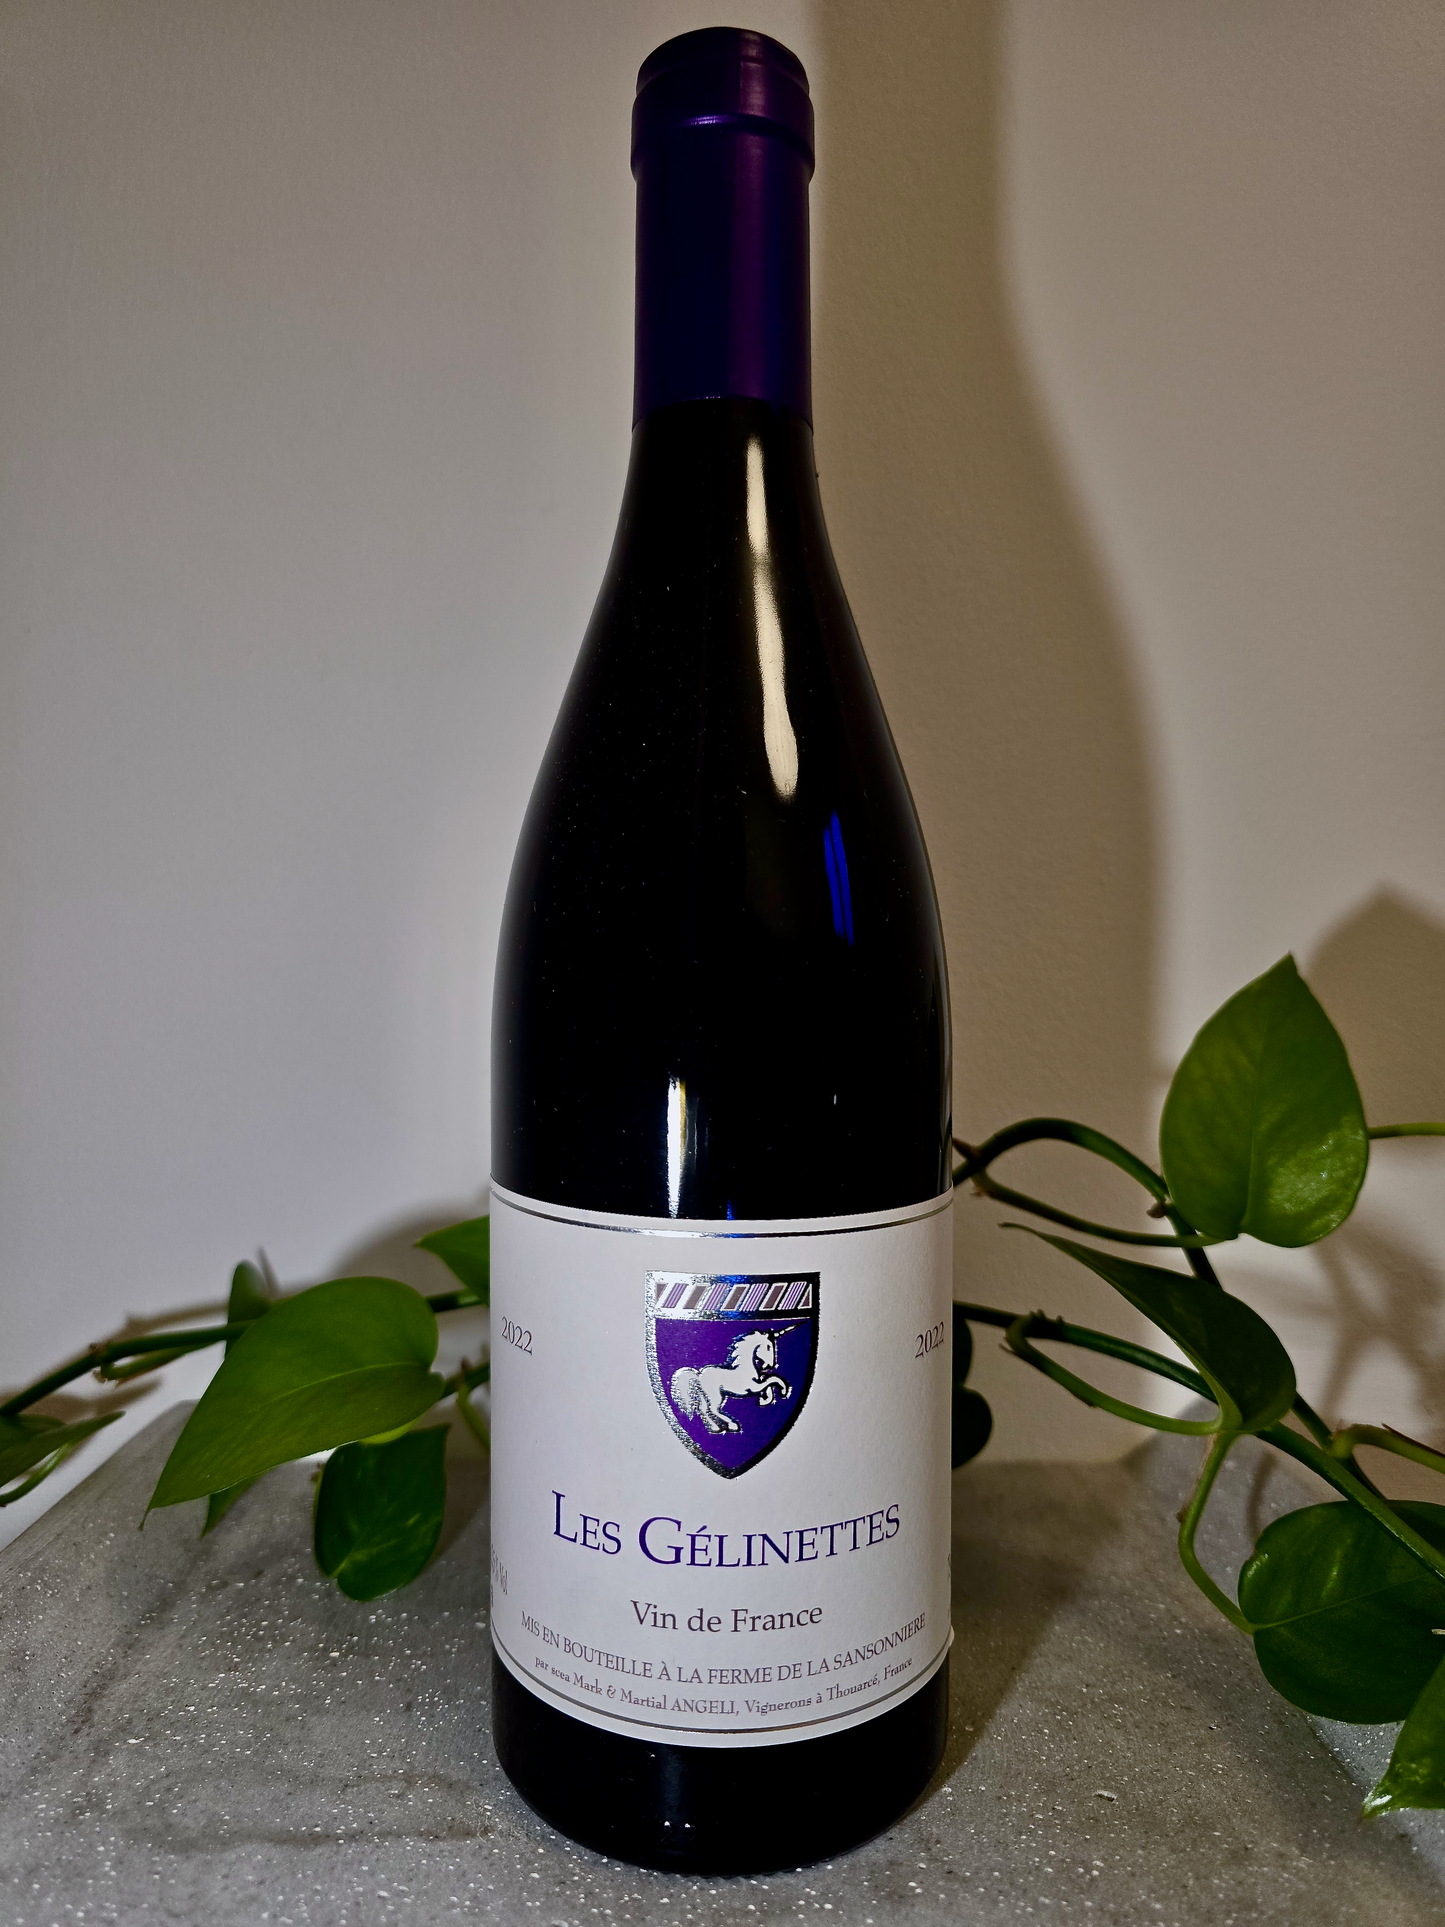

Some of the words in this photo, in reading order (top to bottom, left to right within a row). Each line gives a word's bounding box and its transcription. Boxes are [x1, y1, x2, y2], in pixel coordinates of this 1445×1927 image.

[501, 1316, 533, 1356] 2022
[914, 1321, 944, 1359] 2022
[552, 1489, 622, 1555] LES
[638, 1503, 900, 1567] GÉLINETTES
[631, 1599, 678, 1630] Vin
[687, 1607, 721, 1632] de
[731, 1606, 823, 1632] France
[521, 1610, 540, 1637] MIS
[542, 1625, 560, 1648] EN
[563, 1636, 653, 1679] BOUTEILLE
[657, 1660, 672, 1681] À
[677, 1666, 703, 1684] LA
[707, 1666, 772, 1685] FERME
[777, 1662, 802, 1681] DE
[807, 1657, 829, 1676] LA
[833, 1612, 926, 1670] SANSONNIERE
[535, 1656, 549, 1672] par
[551, 1665, 570, 1682] scea
[573, 1672, 603, 1696] Mark
[606, 1685, 616, 1698] &
[620, 1687, 667, 1710] Martial
[670, 1697, 739, 1716] ANGELI,
[745, 1694, 812, 1716] Vignerons
[816, 1692, 823, 1704] à
[826, 1673, 881, 1701] Thouarcé,
[883, 1656, 913, 1681] France
